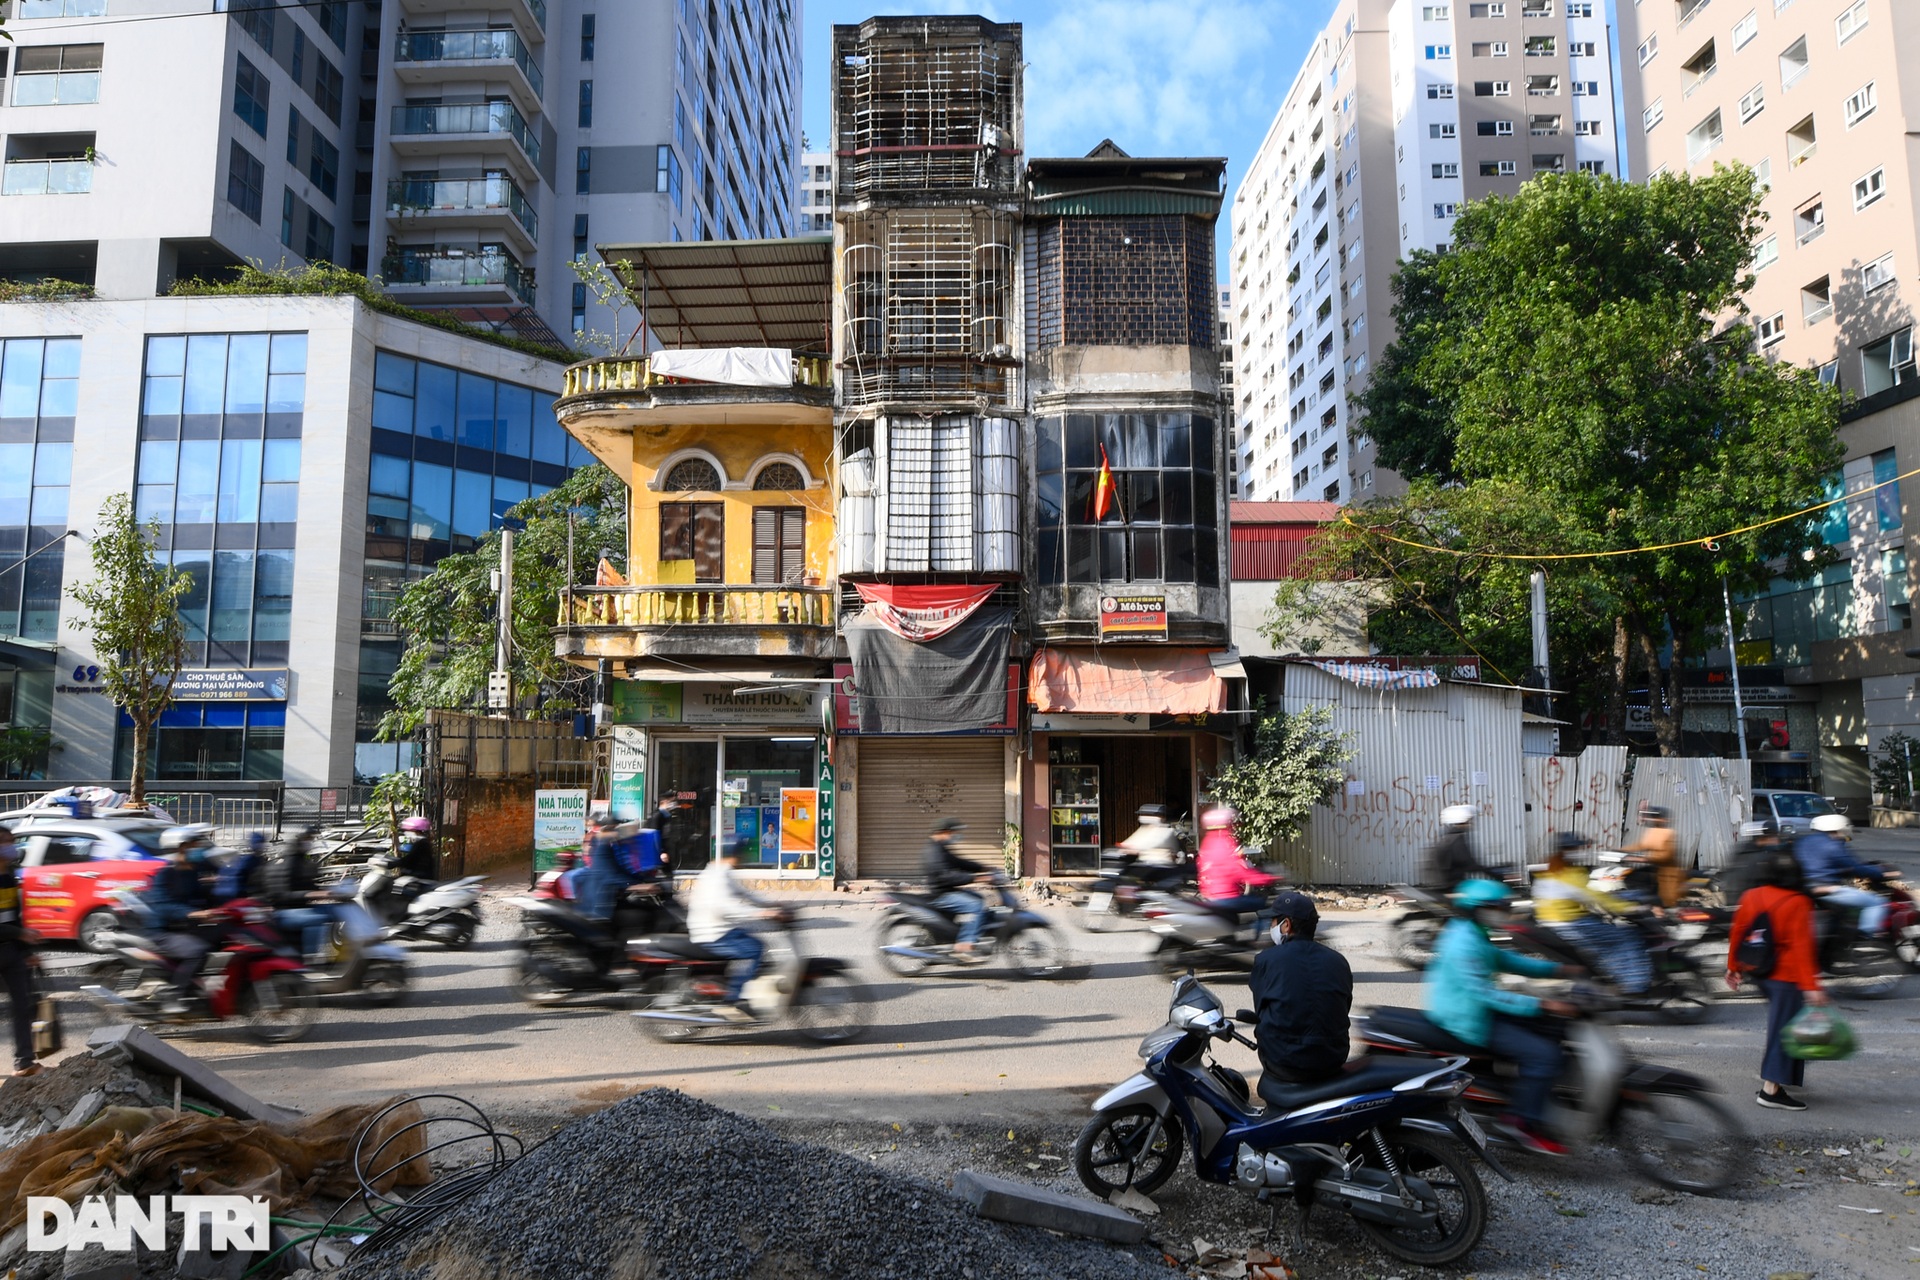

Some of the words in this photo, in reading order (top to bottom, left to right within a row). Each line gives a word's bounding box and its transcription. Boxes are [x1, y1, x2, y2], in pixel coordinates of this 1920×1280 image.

[73, 665, 99, 682] 69
[186, 673, 204, 681] CHO
[205, 673, 226, 681] THUÊ
[227, 672, 244, 681] SÀN
[171, 681, 200, 689] HƯƠNG
[202, 681, 217, 690] MẠI
[218, 681, 235, 689] VĂN
[236, 681, 264, 689] PHÒNG
[703, 693, 756, 705] THANH
[761, 693, 813, 706] HUYN
[616, 747, 644, 756] THANH
[538, 795, 556, 810] NHÀ
[558, 793, 584, 809] THUỐC
